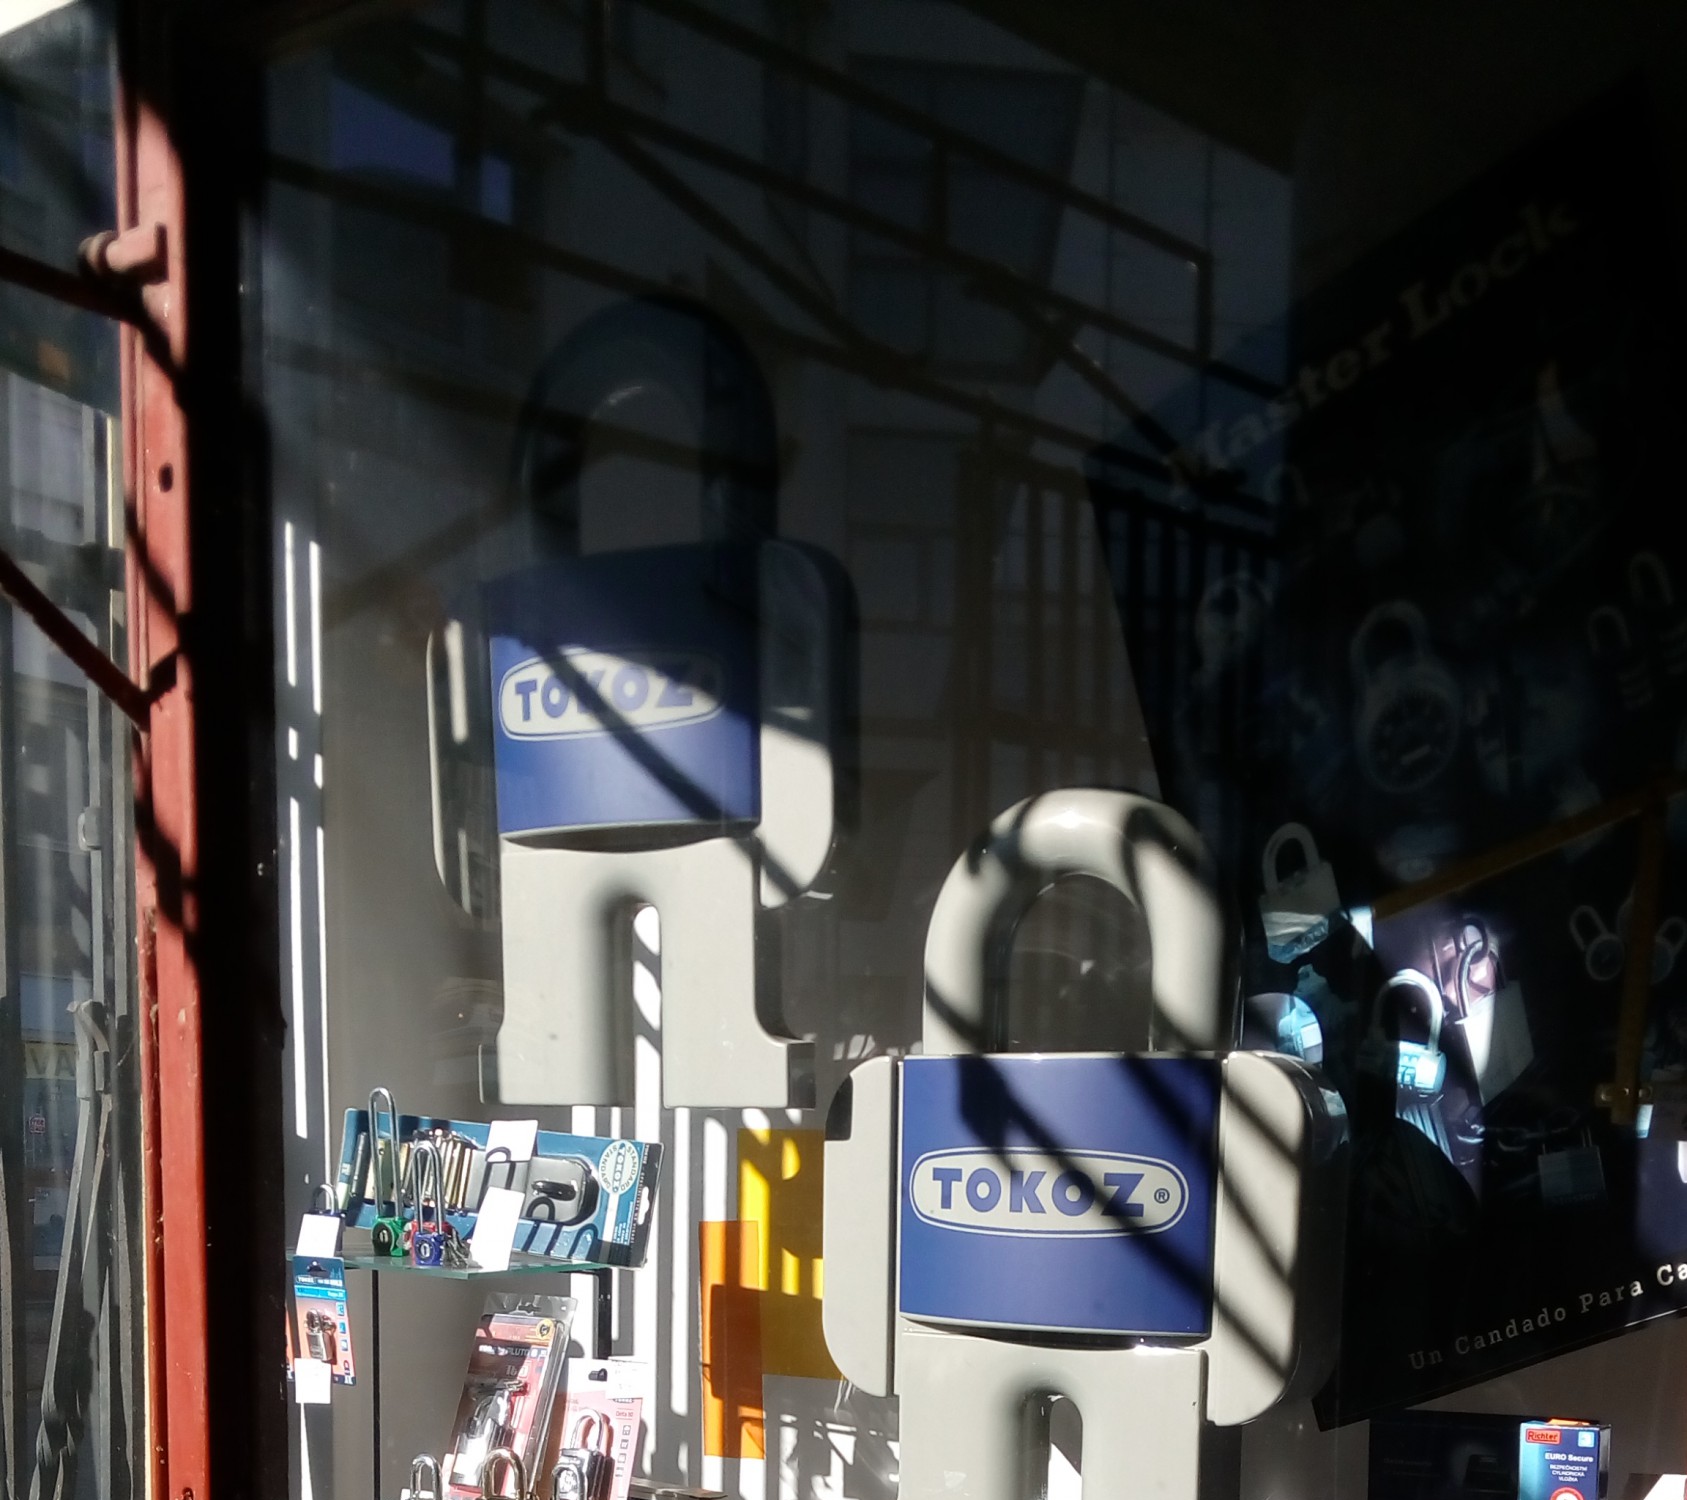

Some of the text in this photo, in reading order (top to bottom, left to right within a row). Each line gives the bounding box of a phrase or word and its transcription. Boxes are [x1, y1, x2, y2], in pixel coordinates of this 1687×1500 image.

[932, 1166, 1145, 1218] TOKOZ
[1408, 1349, 1443, 1370] Un
[1455, 1305, 1567, 1355] Candado
[1578, 1279, 1644, 1314] Para
[1527, 1430, 1559, 1442] Richter
[1545, 1452, 1594, 1463] EURO Secure
